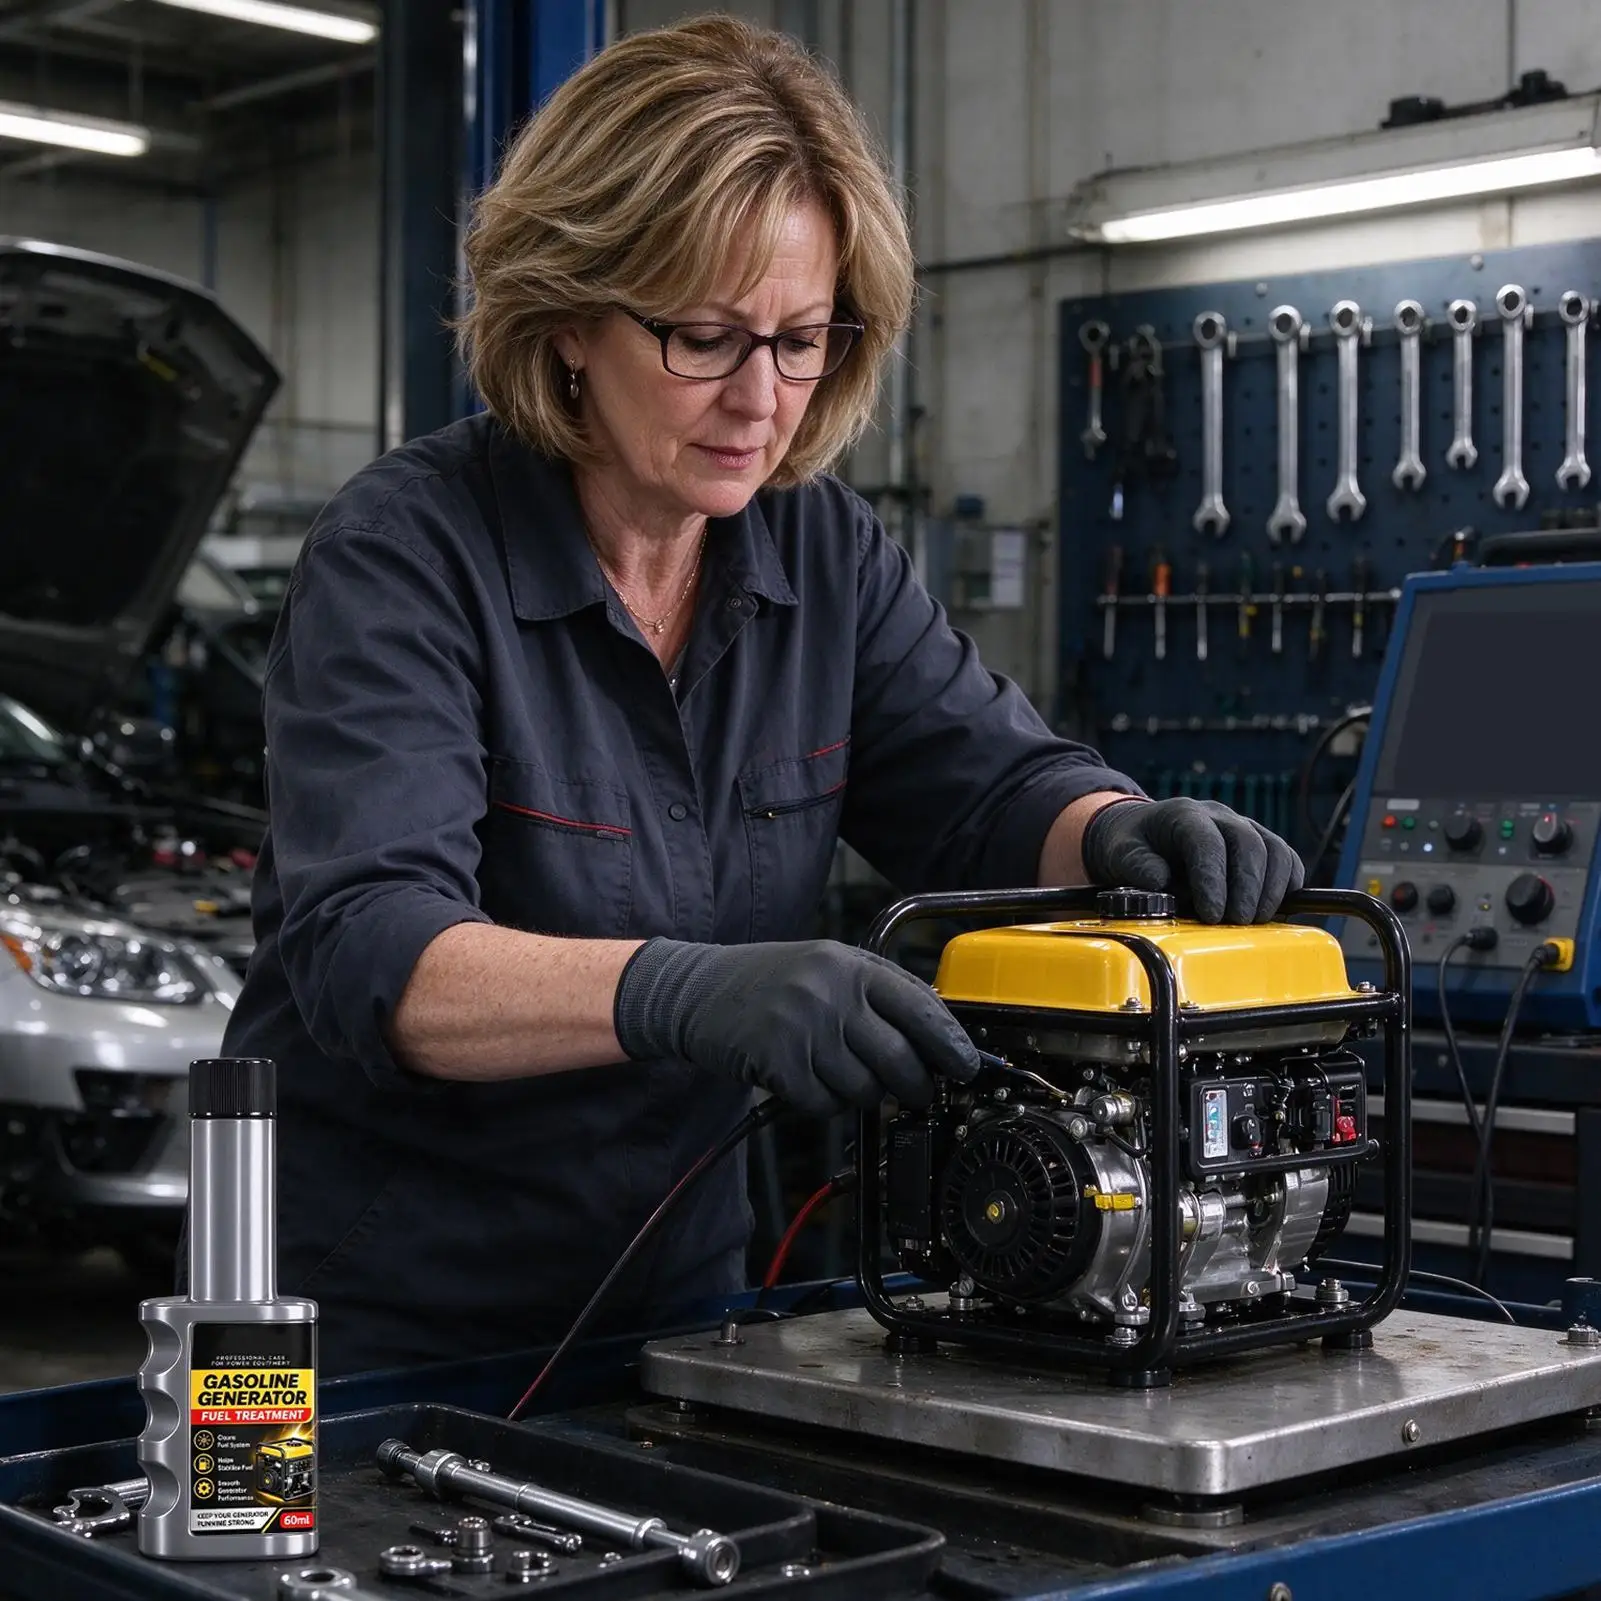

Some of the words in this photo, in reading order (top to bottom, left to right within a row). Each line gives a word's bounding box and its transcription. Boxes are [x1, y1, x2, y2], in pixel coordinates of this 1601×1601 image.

[203, 1374, 299, 1389] GASOLINE
[198, 1390, 307, 1406] GENERATOR
[201, 1411, 231, 1422] FUEL
[235, 1410, 304, 1420] TREATMENT
[284, 1516, 310, 1526] 60ml
